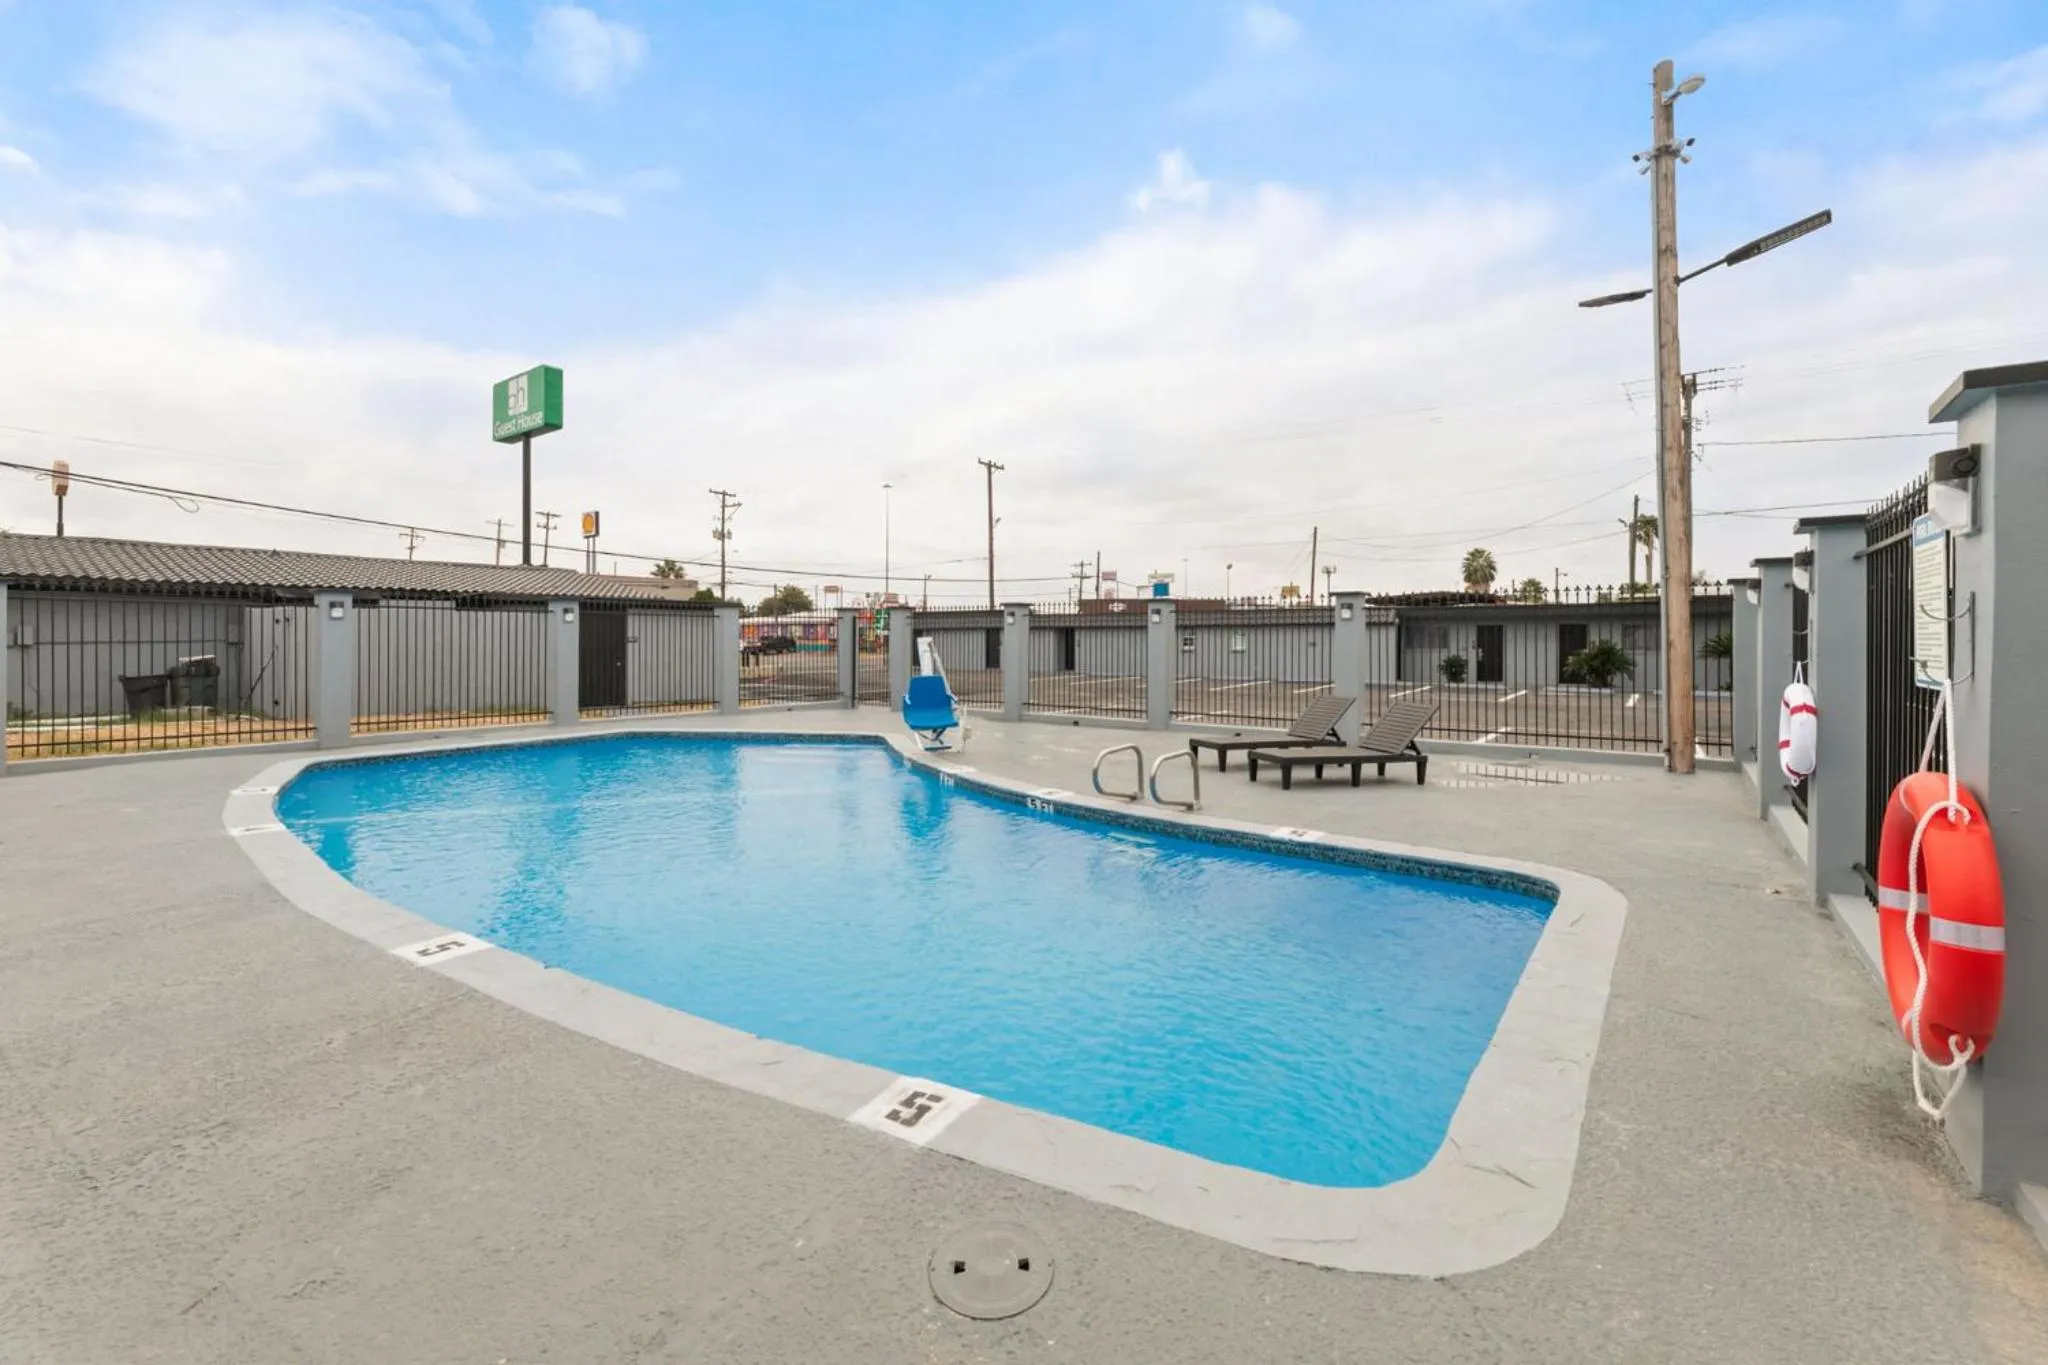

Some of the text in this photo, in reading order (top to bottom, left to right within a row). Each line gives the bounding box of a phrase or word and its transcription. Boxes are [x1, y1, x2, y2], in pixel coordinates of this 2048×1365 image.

[495, 411, 544, 438] Guest House
[884, 1090, 944, 1128] 5
